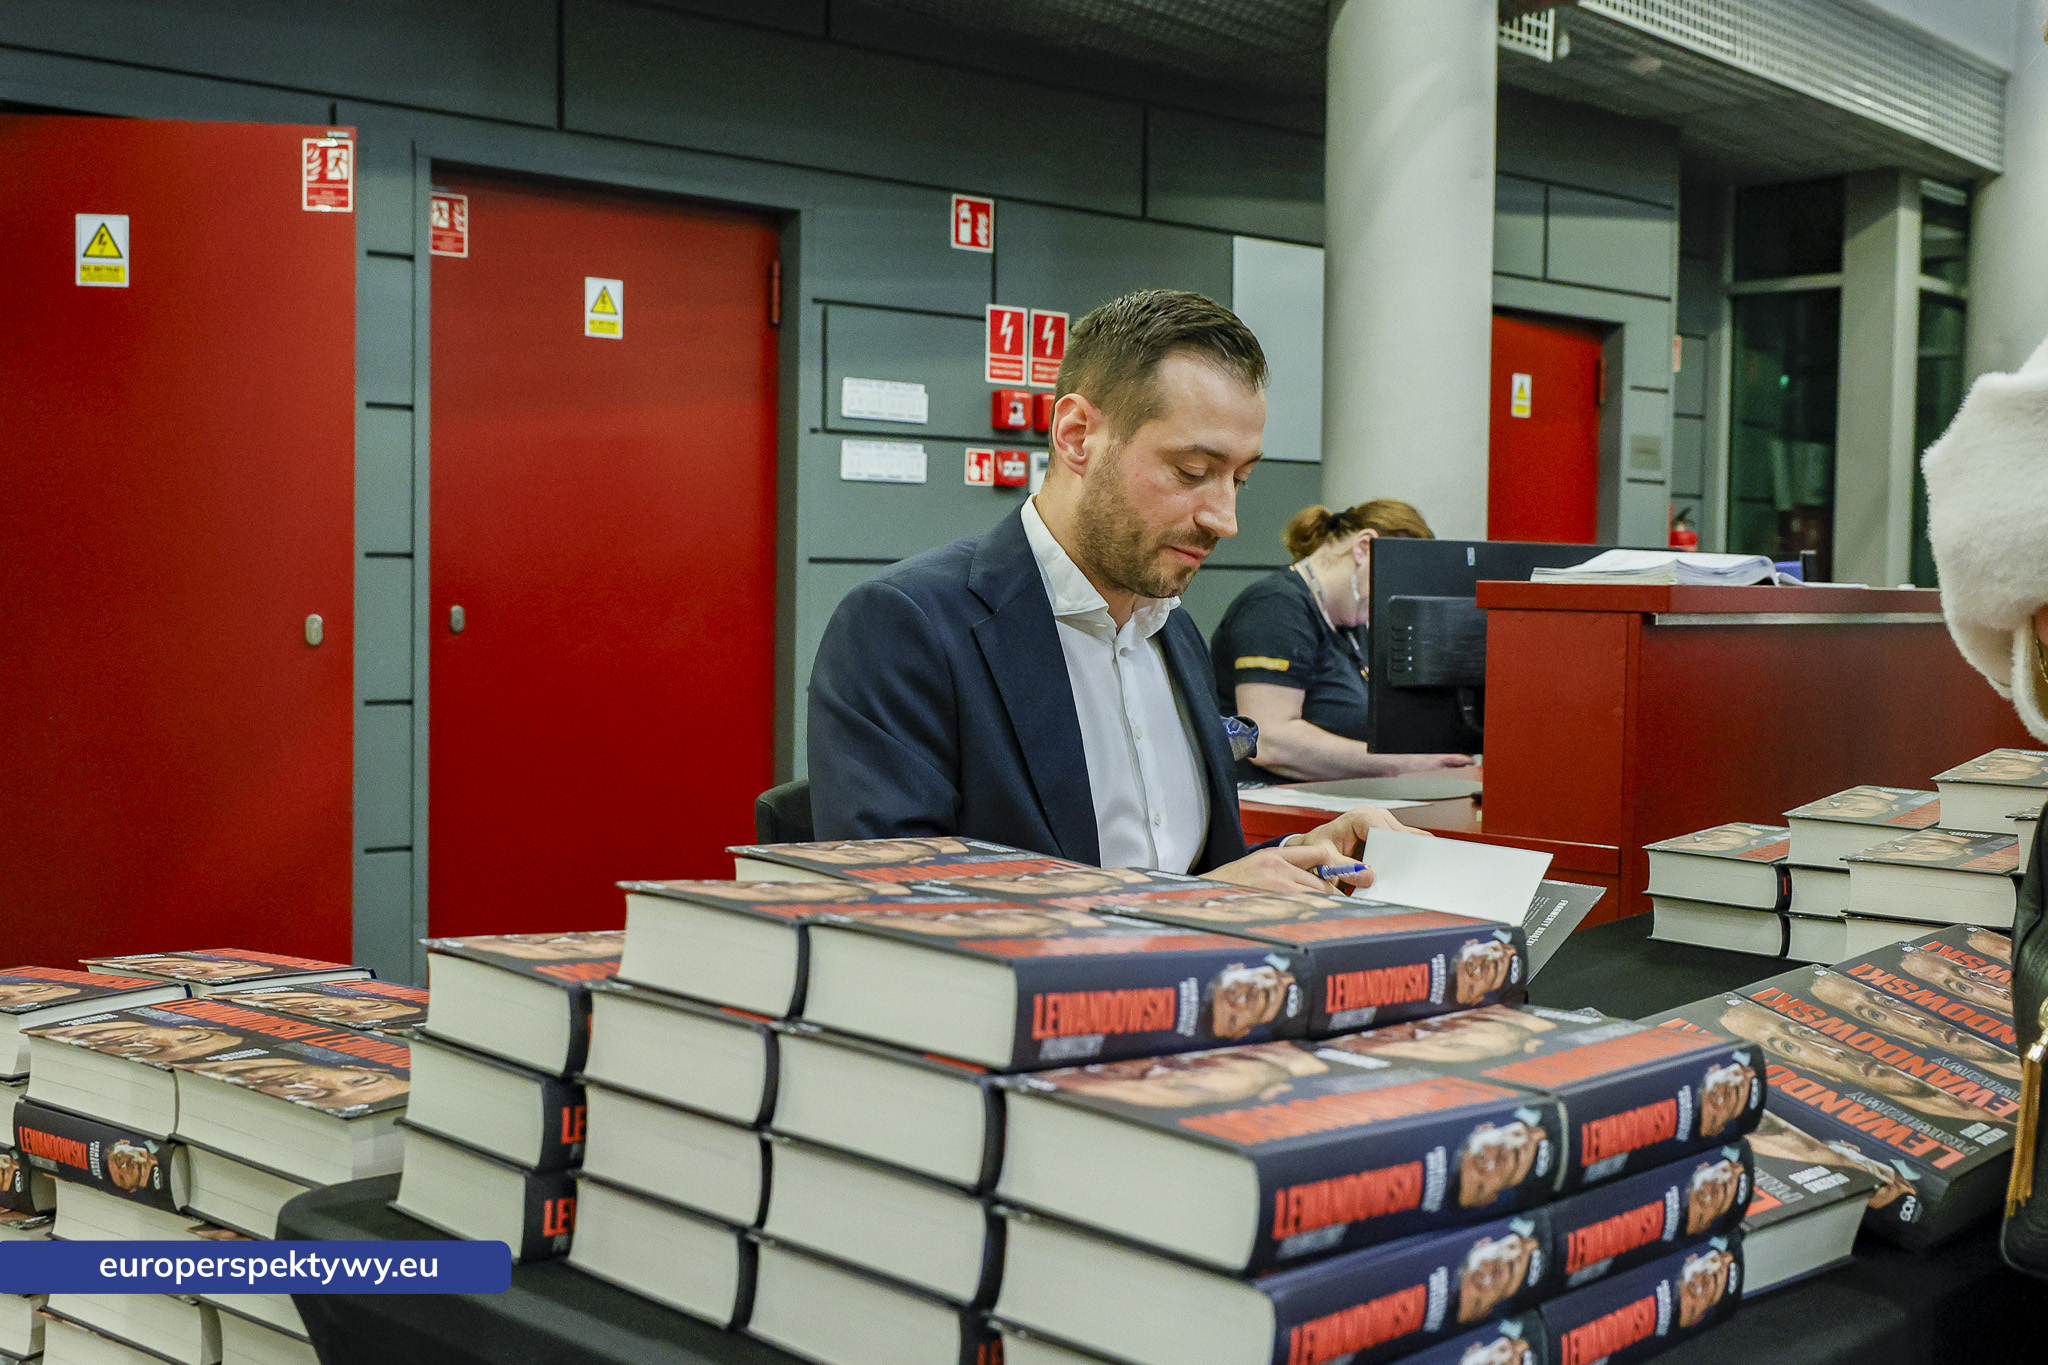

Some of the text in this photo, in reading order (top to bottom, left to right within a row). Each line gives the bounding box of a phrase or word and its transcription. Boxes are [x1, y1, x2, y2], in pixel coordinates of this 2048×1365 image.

[1032, 987, 1176, 1040] LEWANDOWSKI
[1326, 963, 1430, 1013] LEWANDOWSKI
[1847, 963, 2017, 1044] NDOWSKI
[1750, 987, 2021, 1118] EWANDOWSKI
[19, 1126, 89, 1171] LEWANDOWSKI
